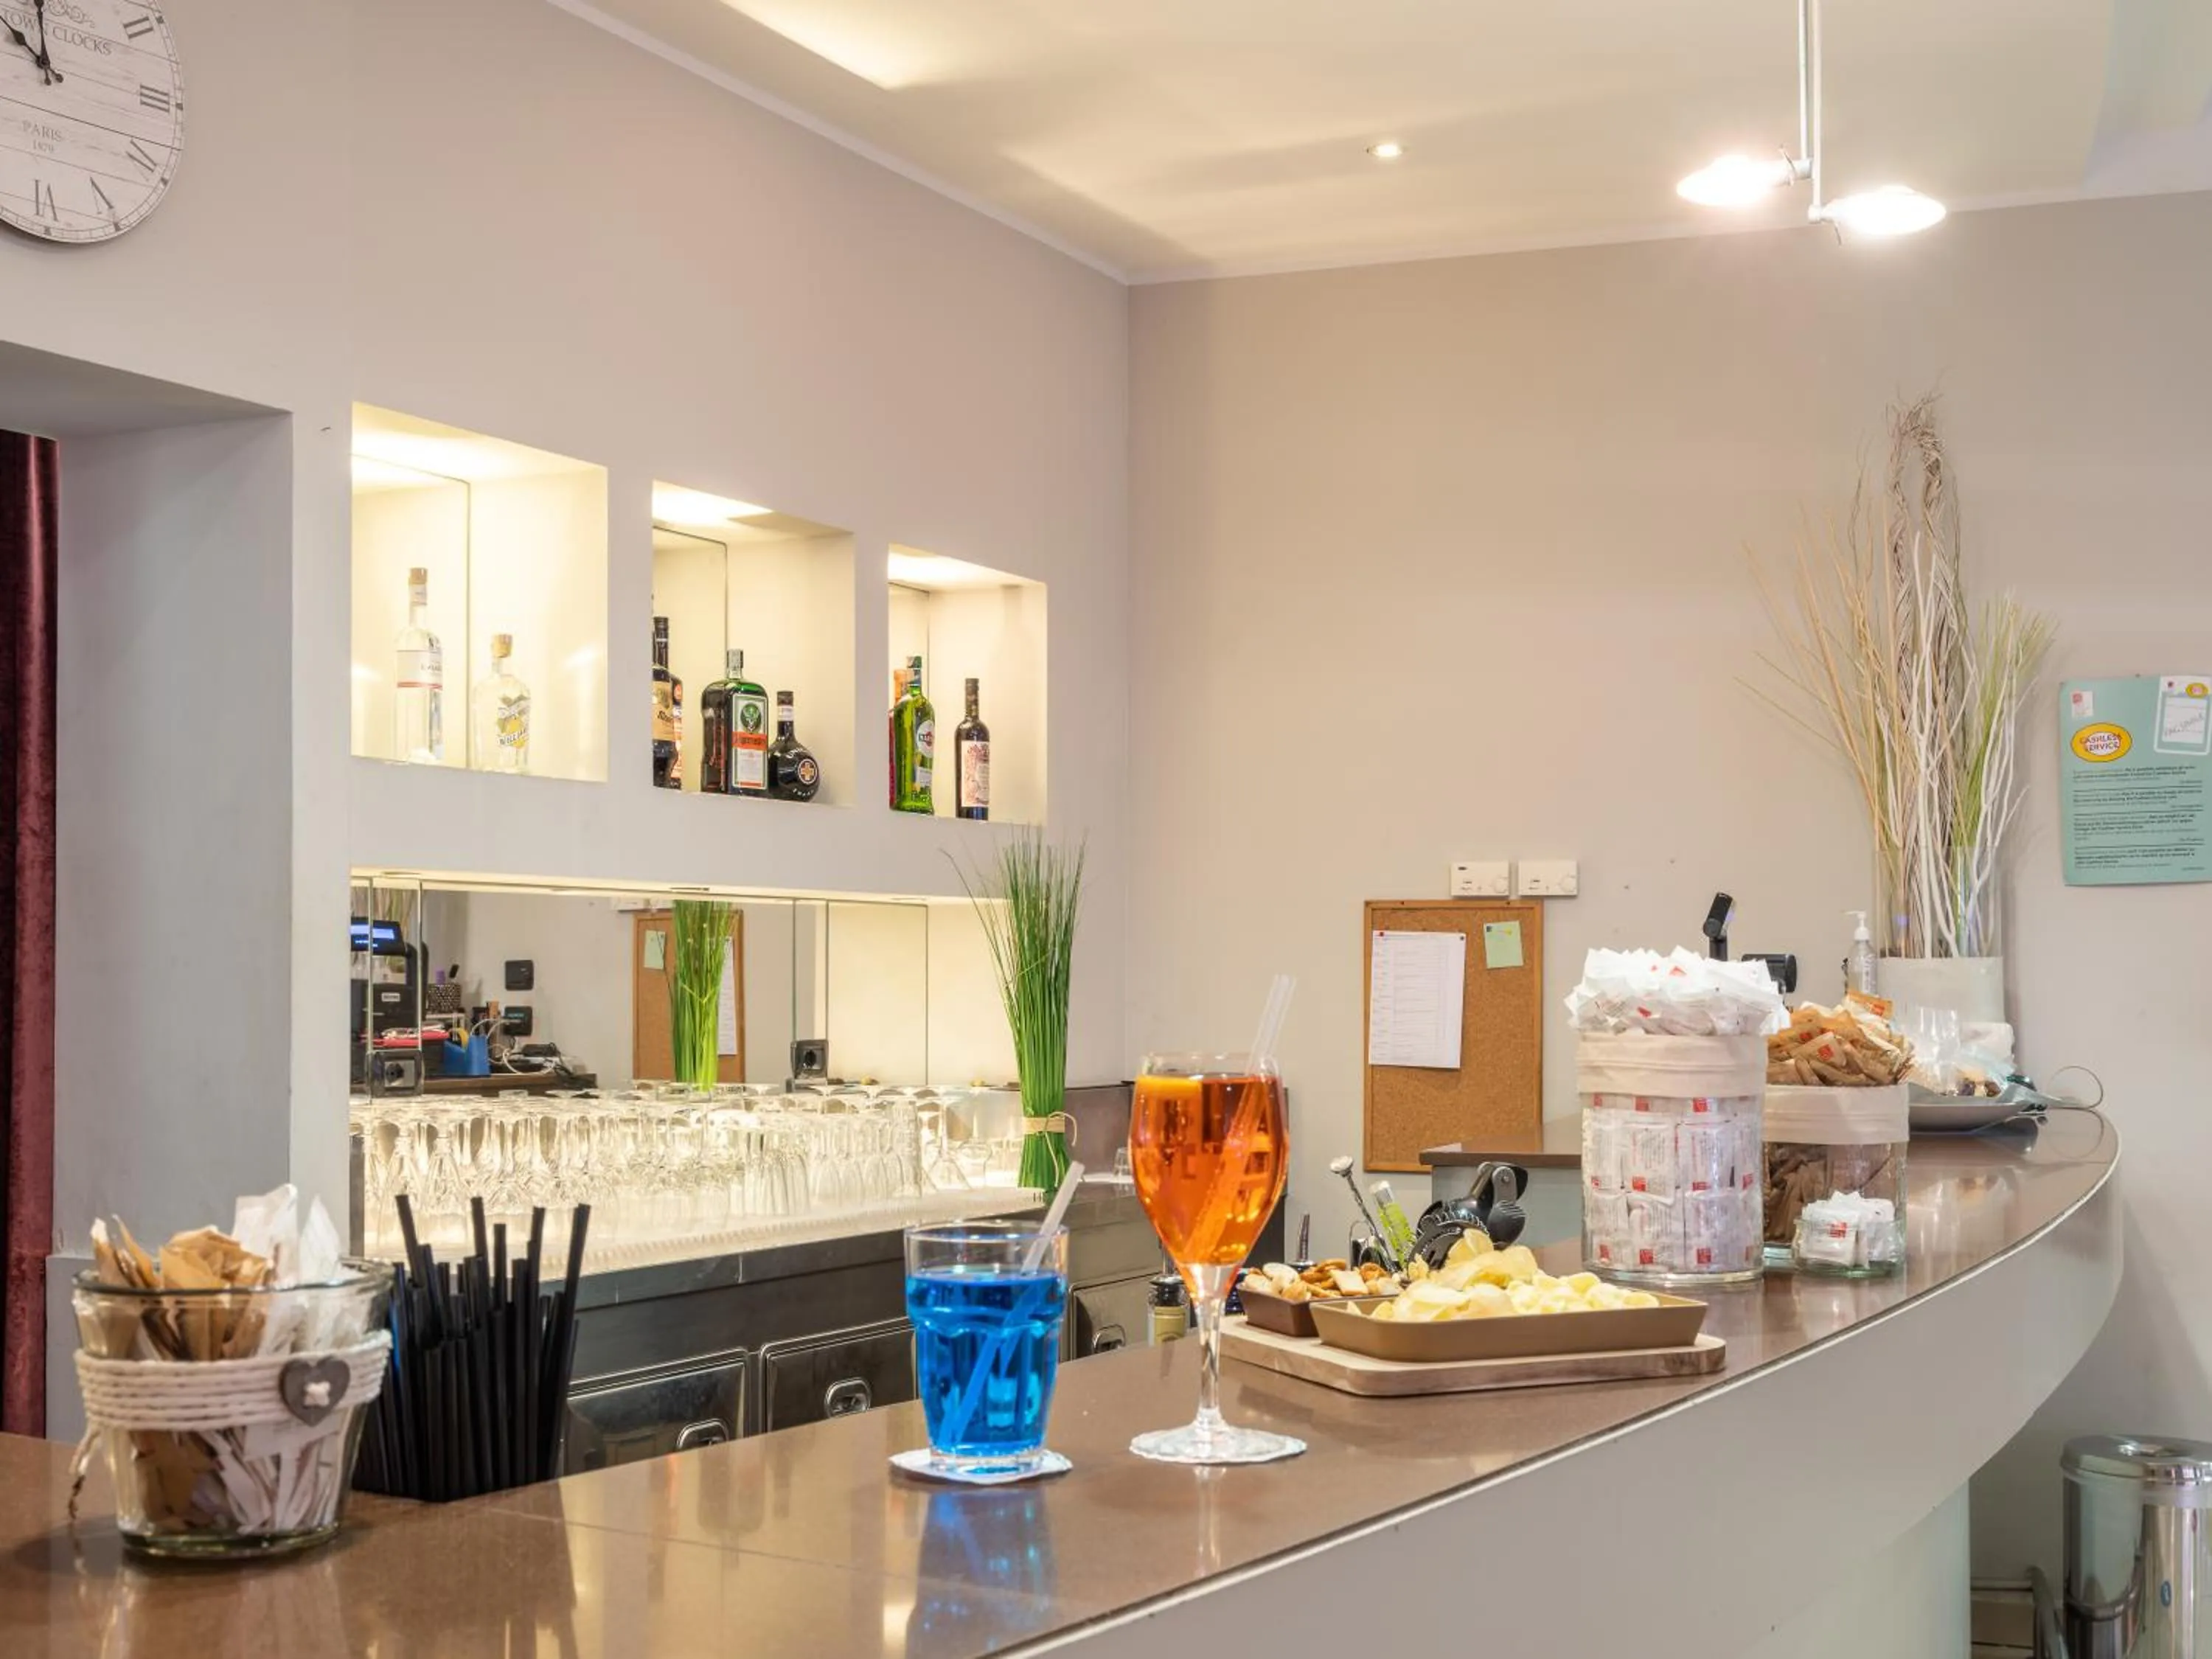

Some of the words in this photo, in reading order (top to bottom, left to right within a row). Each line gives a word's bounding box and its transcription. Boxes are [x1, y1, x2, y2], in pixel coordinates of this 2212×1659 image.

[52, 25, 112, 56] CLOCKS
[139, 84, 170, 113] III
[22, 120, 63, 142] PARIS
